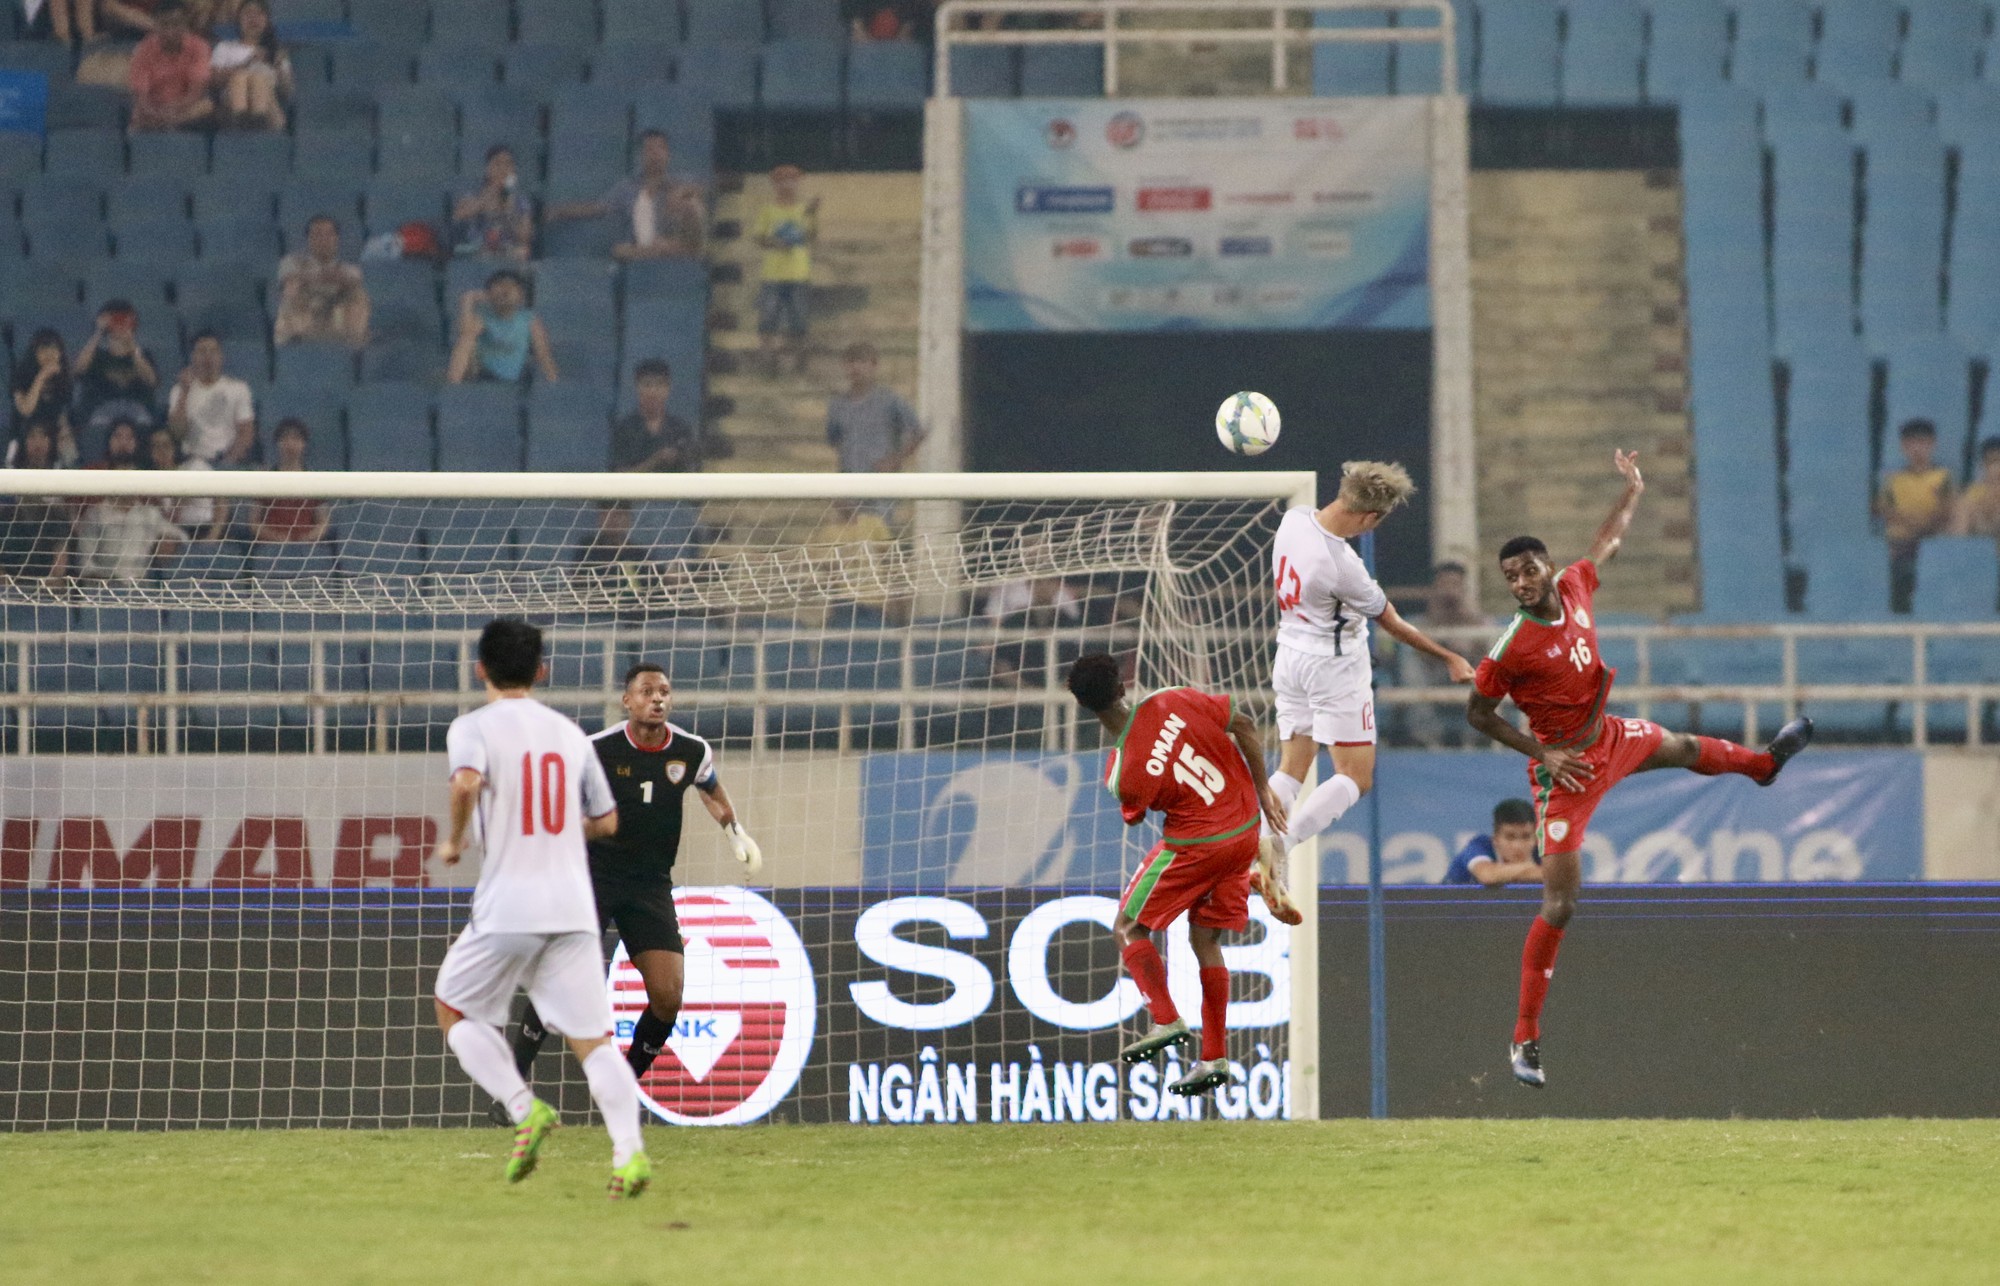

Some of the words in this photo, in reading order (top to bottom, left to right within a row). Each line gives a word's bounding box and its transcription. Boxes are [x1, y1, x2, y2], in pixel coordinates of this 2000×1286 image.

[1569, 637, 1592, 672] 16
[1146, 712, 1187, 776] OMAN
[1173, 742, 1226, 806] 15
[521, 751, 566, 836] 10
[640, 780, 653, 804] 1
[0, 816, 438, 889] MAR
[616, 1019, 717, 1038] BNK
[848, 1045, 976, 1122] NGÂN
[990, 1045, 1118, 1122] HÀNG
[1215, 1043, 1291, 1121] GÒ
